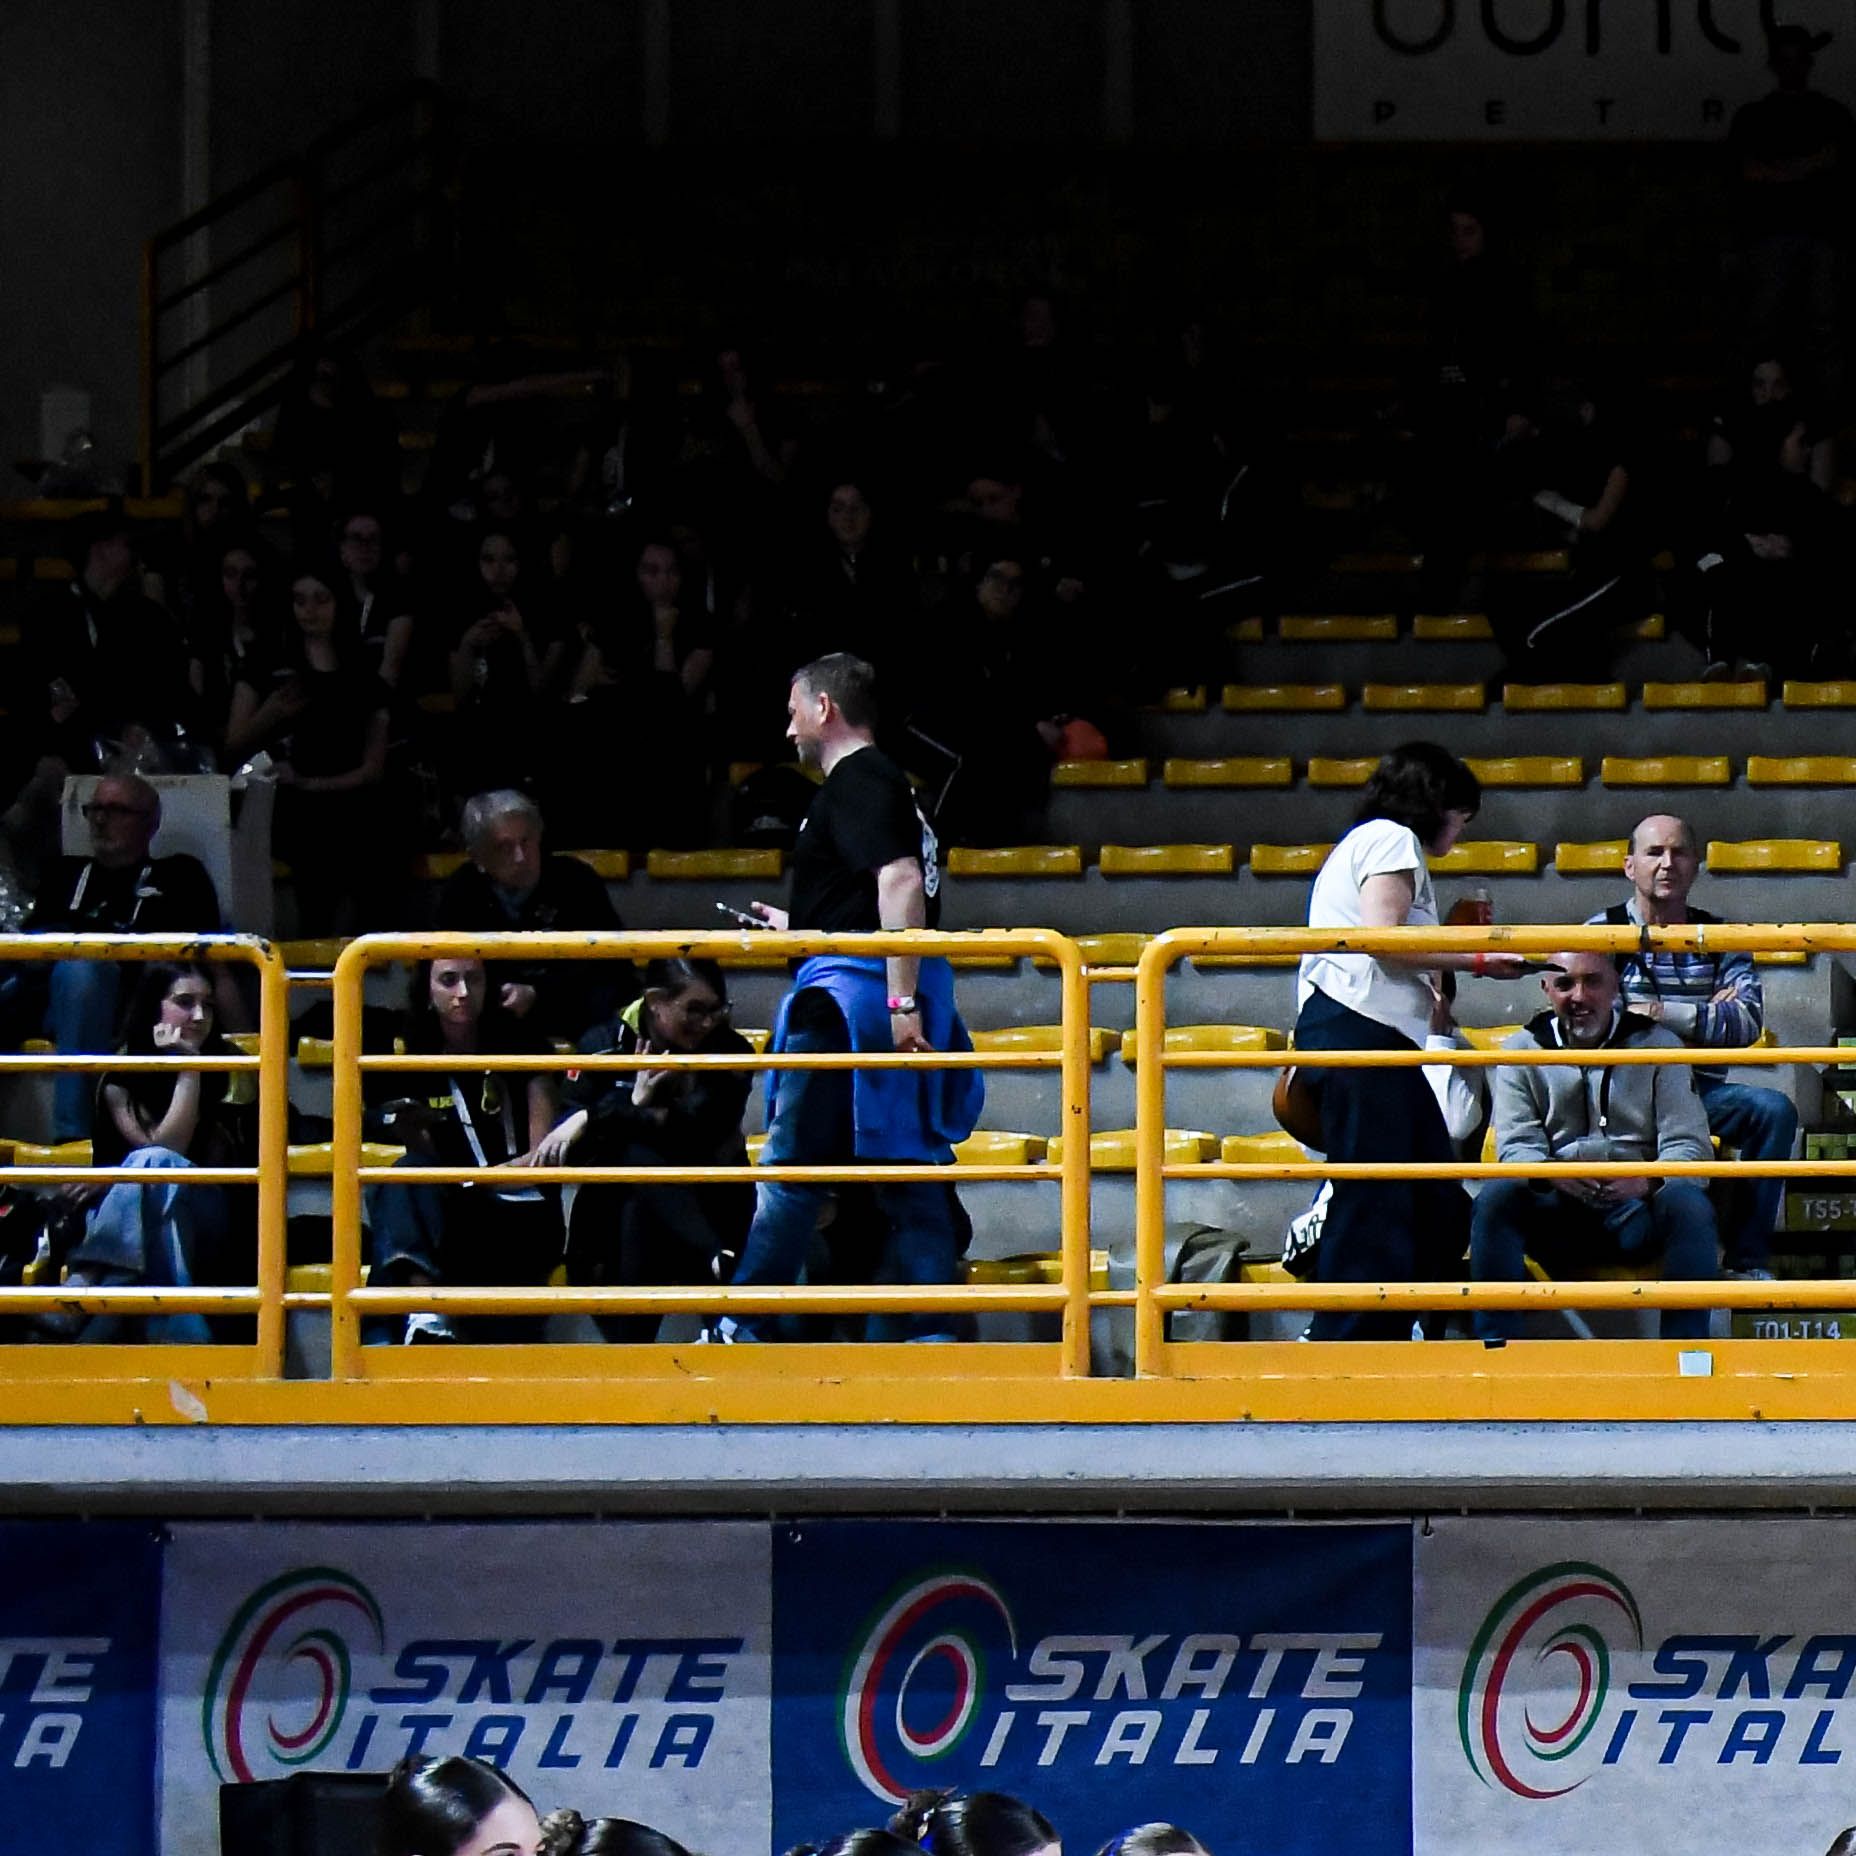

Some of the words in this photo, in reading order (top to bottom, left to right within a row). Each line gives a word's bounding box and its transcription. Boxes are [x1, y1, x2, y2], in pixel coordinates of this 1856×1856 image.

[367, 1637, 745, 1705] SKATE
[1005, 1632, 1384, 1702] SKATE
[345, 1712, 716, 1770] ITALIA
[980, 1708, 1354, 1766] ITALIA
